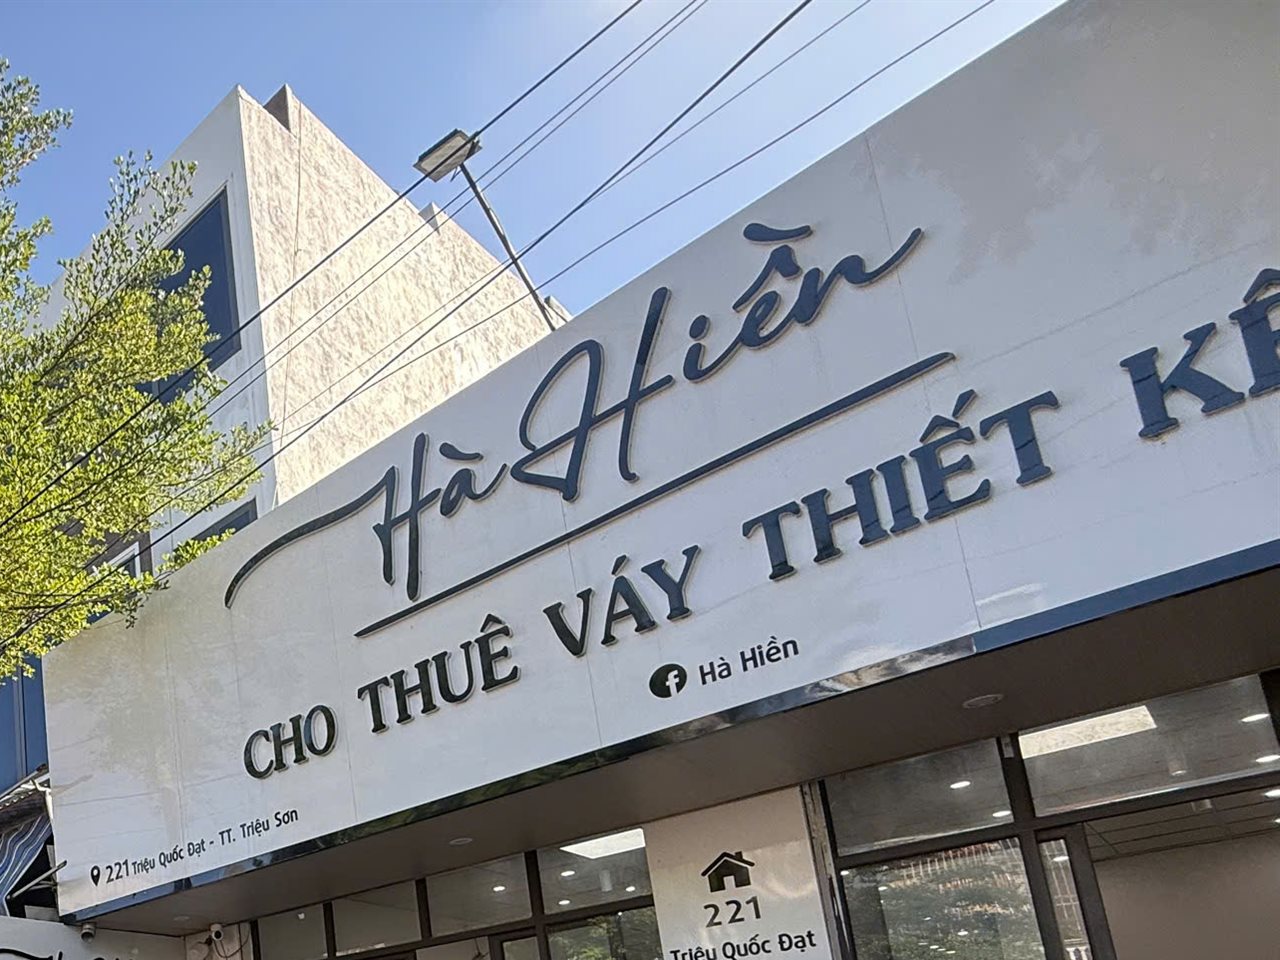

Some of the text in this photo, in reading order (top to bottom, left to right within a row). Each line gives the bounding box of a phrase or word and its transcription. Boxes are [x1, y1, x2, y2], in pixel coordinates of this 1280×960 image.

[225, 223, 922, 608] Hà Hiền
[243, 704, 338, 780] CHO
[357, 613, 521, 734] THUÊ
[544, 545, 700, 656] VÁY
[742, 388, 1061, 581] THIẾT
[698, 656, 733, 686] Hà
[739, 635, 800, 673] Hiền
[105, 859, 130, 884] 221
[131, 858, 156, 876] Triệu
[158, 844, 185, 869] Quốc
[187, 838, 207, 861] Đạt
[219, 828, 237, 847] TT.
[240, 818, 271, 839] Triệu
[274, 808, 299, 828] Sơn
[703, 896, 762, 928] 221
[778, 930, 817, 952] Đạt
